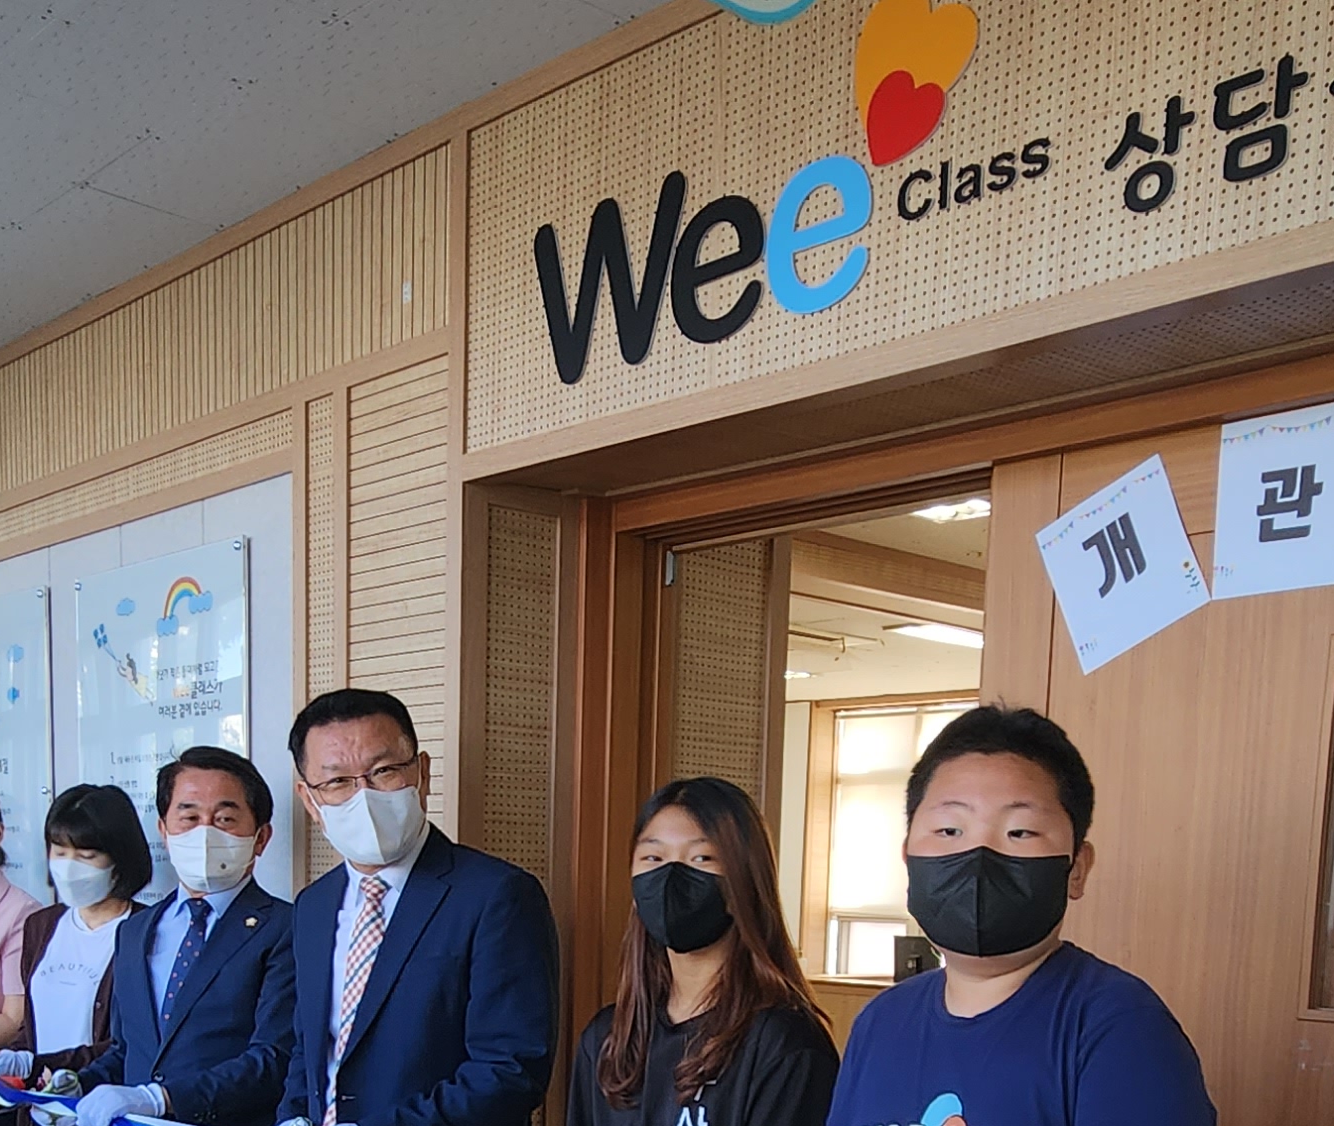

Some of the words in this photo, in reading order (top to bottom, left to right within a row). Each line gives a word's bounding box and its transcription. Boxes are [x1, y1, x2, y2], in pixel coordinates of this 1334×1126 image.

[534, 155, 873, 384] Wee
[897, 137, 1052, 220] Class
[1082, 512, 1147, 599] 개
[1256, 464, 1324, 543] 관
